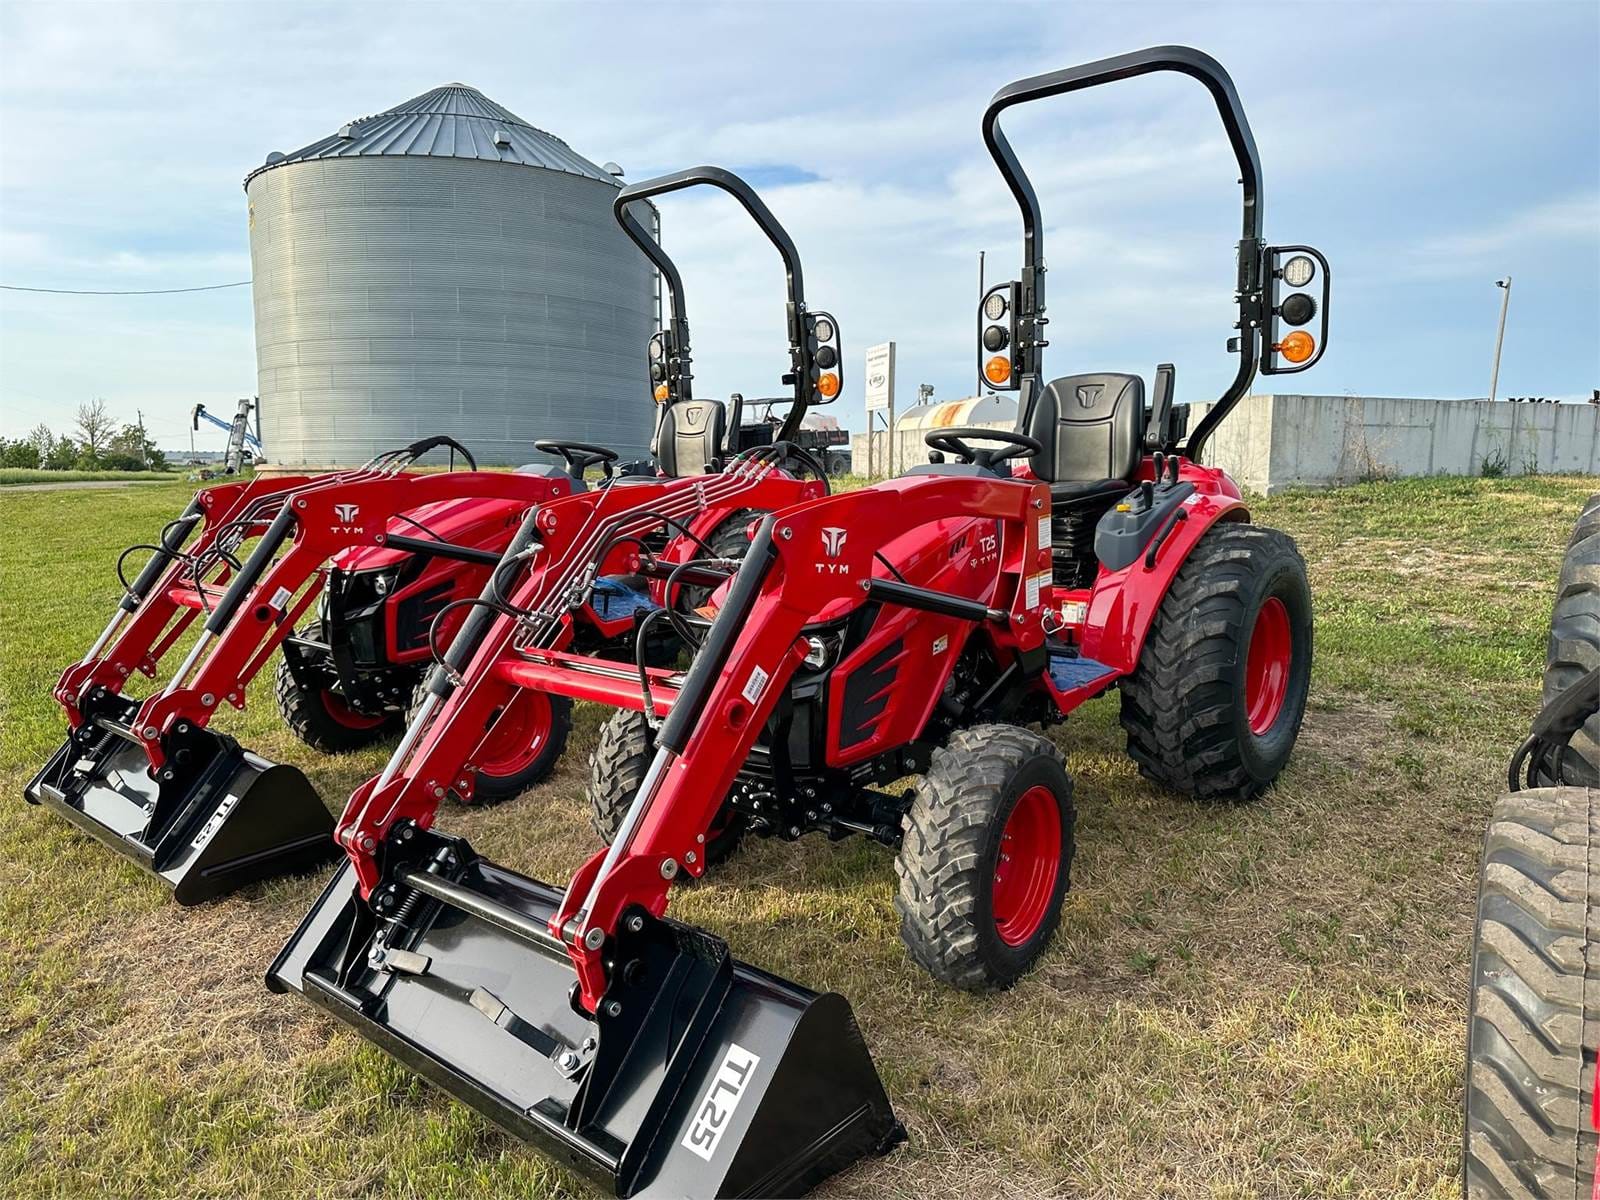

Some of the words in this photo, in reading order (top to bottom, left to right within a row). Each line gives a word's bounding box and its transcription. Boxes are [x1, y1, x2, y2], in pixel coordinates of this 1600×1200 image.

[979, 535, 996, 553] T25
[980, 552, 998, 564] TYM
[815, 563, 849, 574] TYM
[195, 800, 235, 846] TL25
[690, 1060, 753, 1151] TL25
